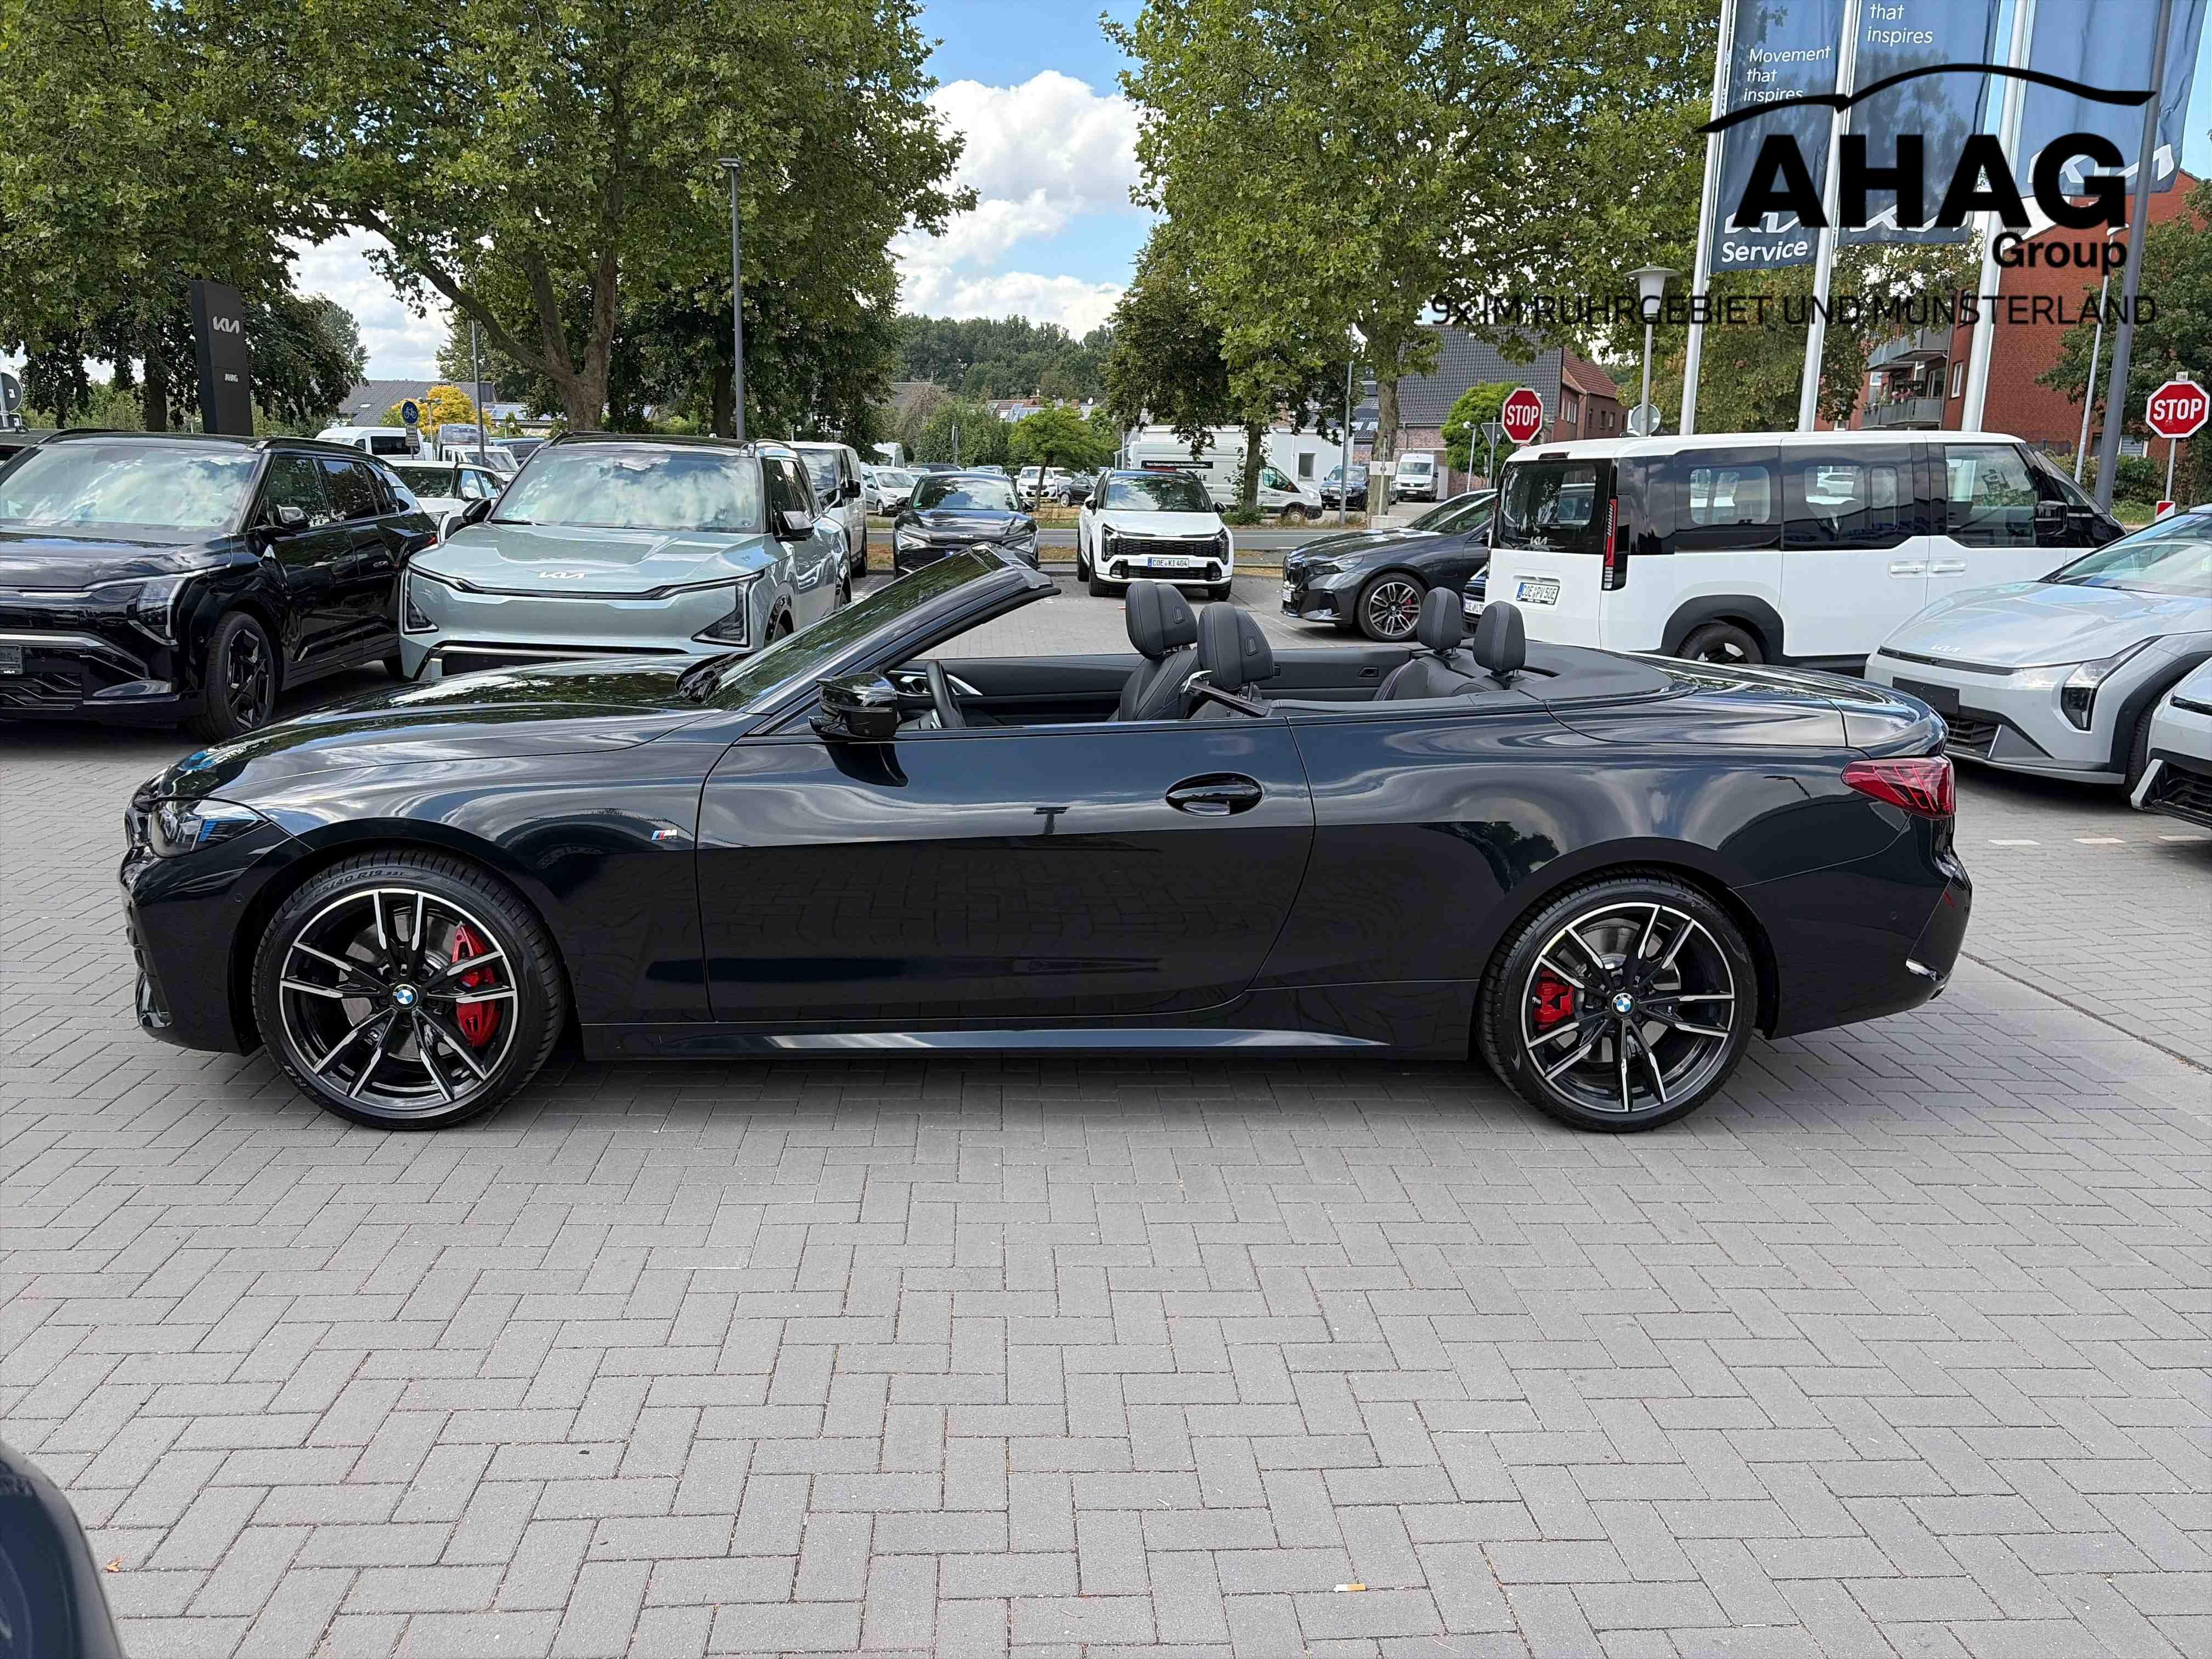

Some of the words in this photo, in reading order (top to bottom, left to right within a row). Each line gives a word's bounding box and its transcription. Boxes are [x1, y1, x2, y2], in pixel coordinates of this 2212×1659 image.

[1870, 3, 1905, 20] that
[1867, 26, 1933, 47] inspires
[1749, 46, 1832, 63] Movement
[1746, 67, 1778, 82] that
[1743, 88, 1804, 103] inspires
[1722, 241, 1809, 263] Service
[212, 316, 240, 334] KIA
[1506, 404, 1539, 426] STOP
[2153, 398, 2203, 421] STOP
[539, 571, 585, 580] KIA
